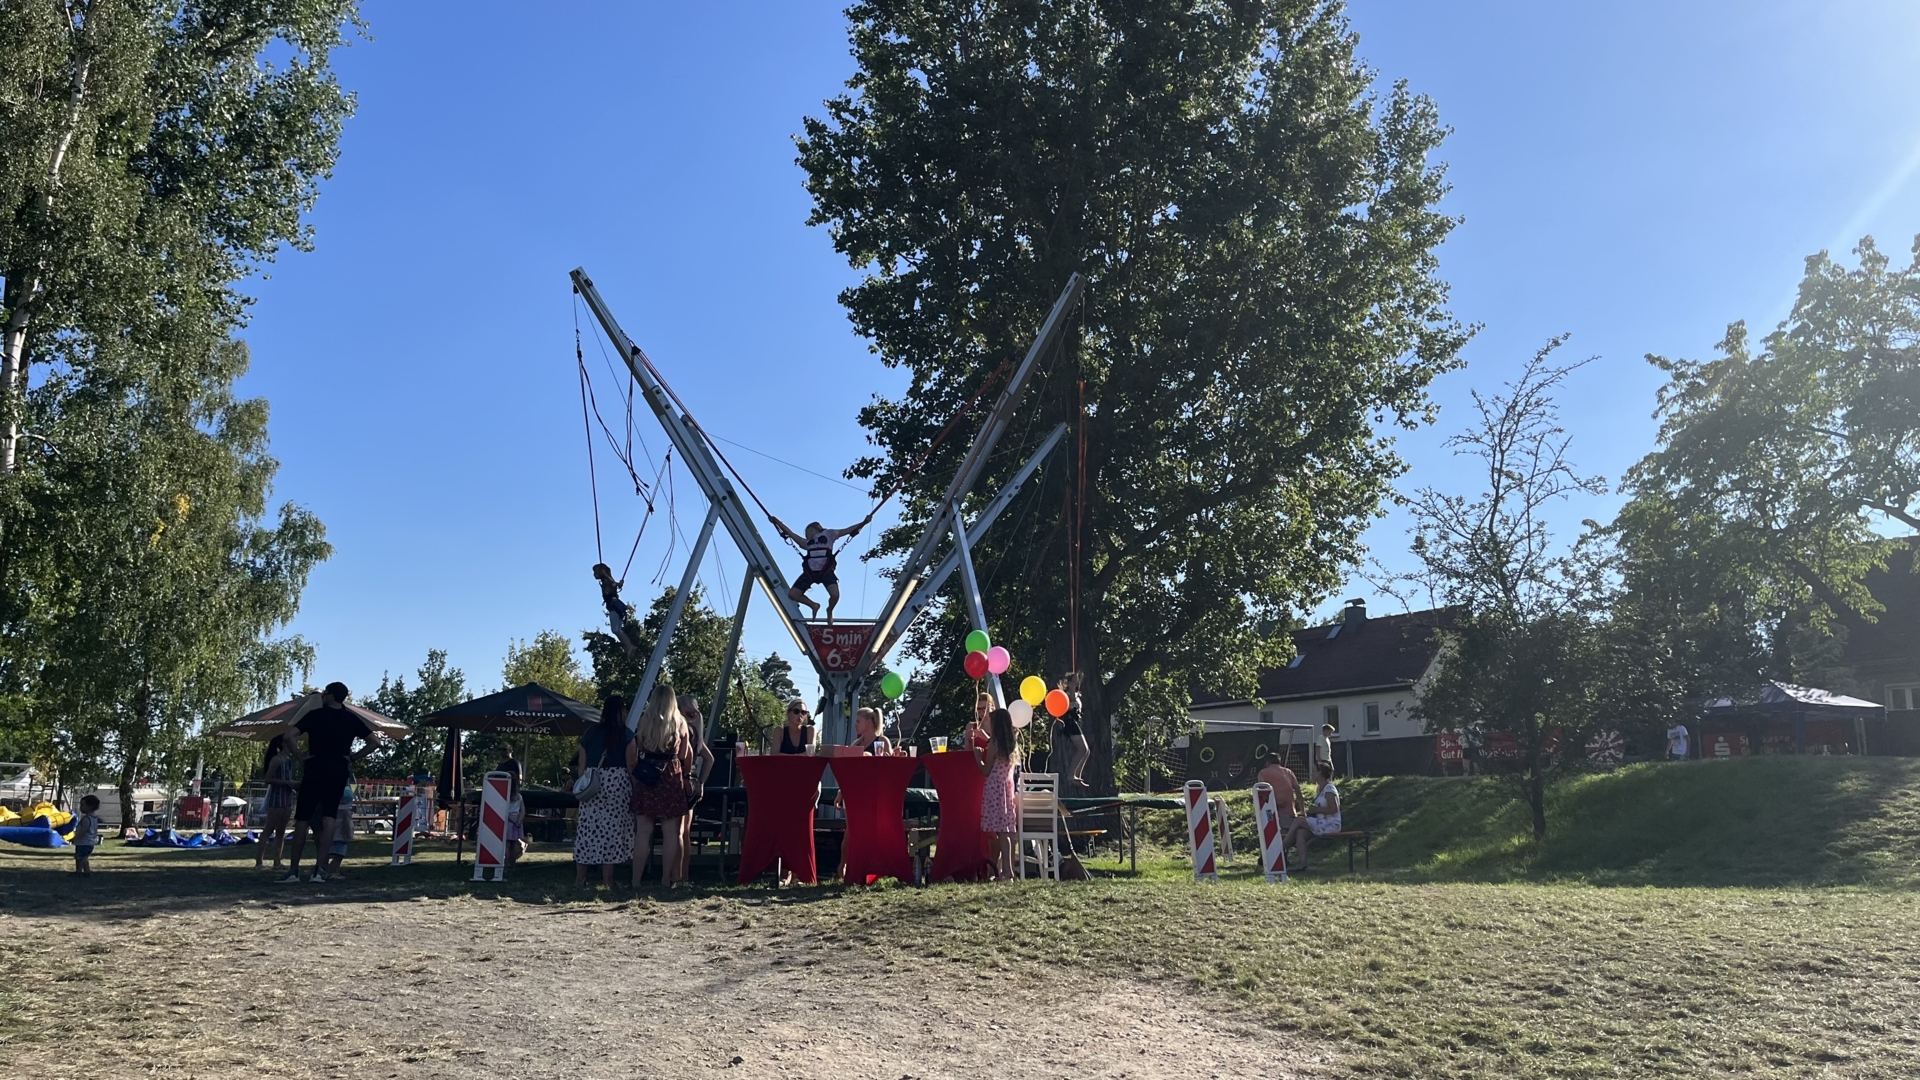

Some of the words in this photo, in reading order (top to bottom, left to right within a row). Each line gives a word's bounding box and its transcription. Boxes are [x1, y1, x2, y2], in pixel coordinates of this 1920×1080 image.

[822, 628, 834, 645] 5
[836, 631, 862, 645] min
[1441, 750, 1455, 759] Gut
